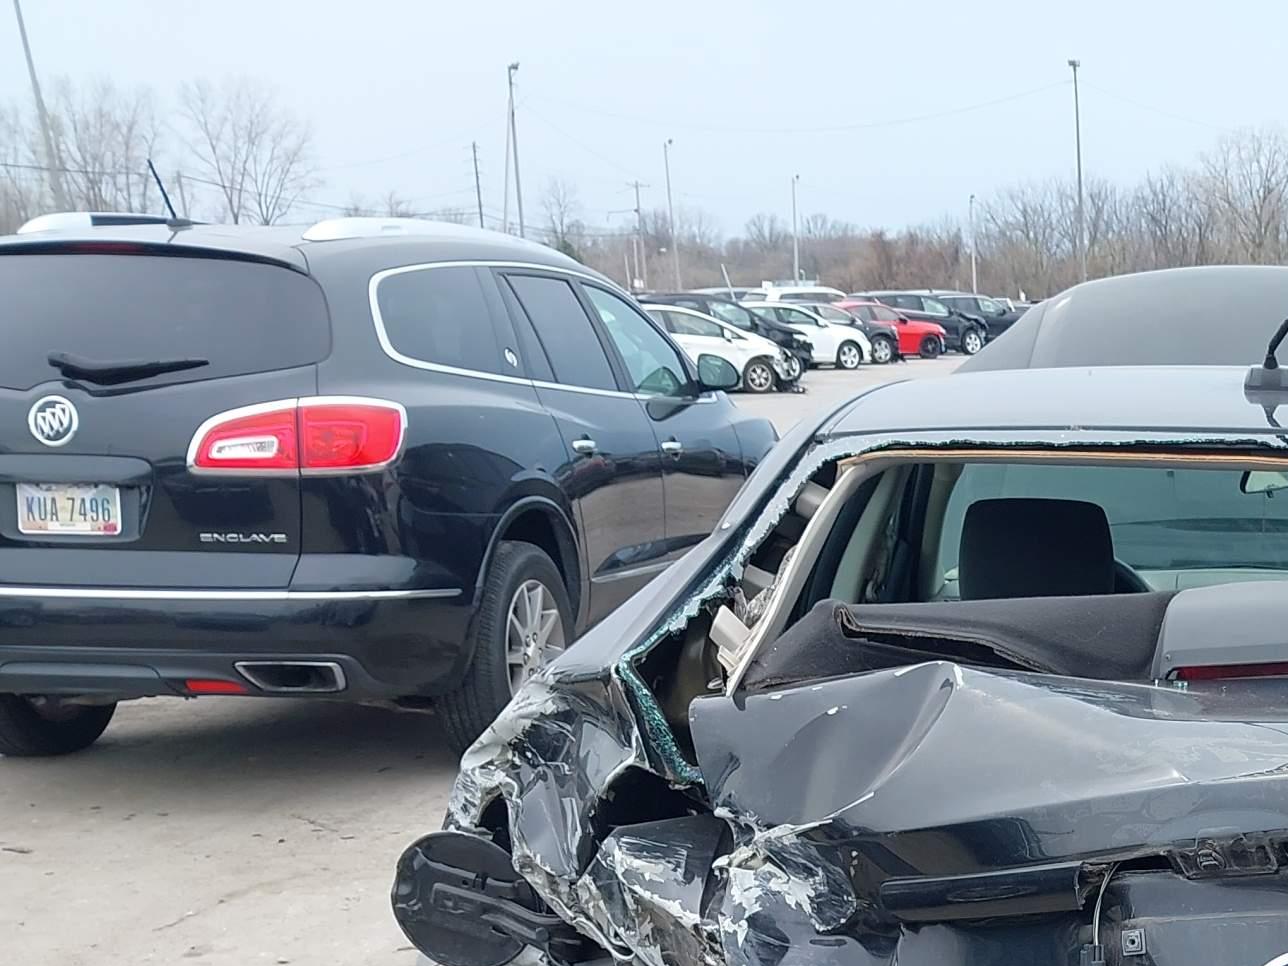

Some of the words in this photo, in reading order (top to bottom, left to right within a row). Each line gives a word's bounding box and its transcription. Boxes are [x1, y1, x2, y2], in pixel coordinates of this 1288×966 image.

[26, 496, 60, 522] KUA
[66, 497, 111, 523] 7496
[199, 532, 287, 543] ENCLAVE
